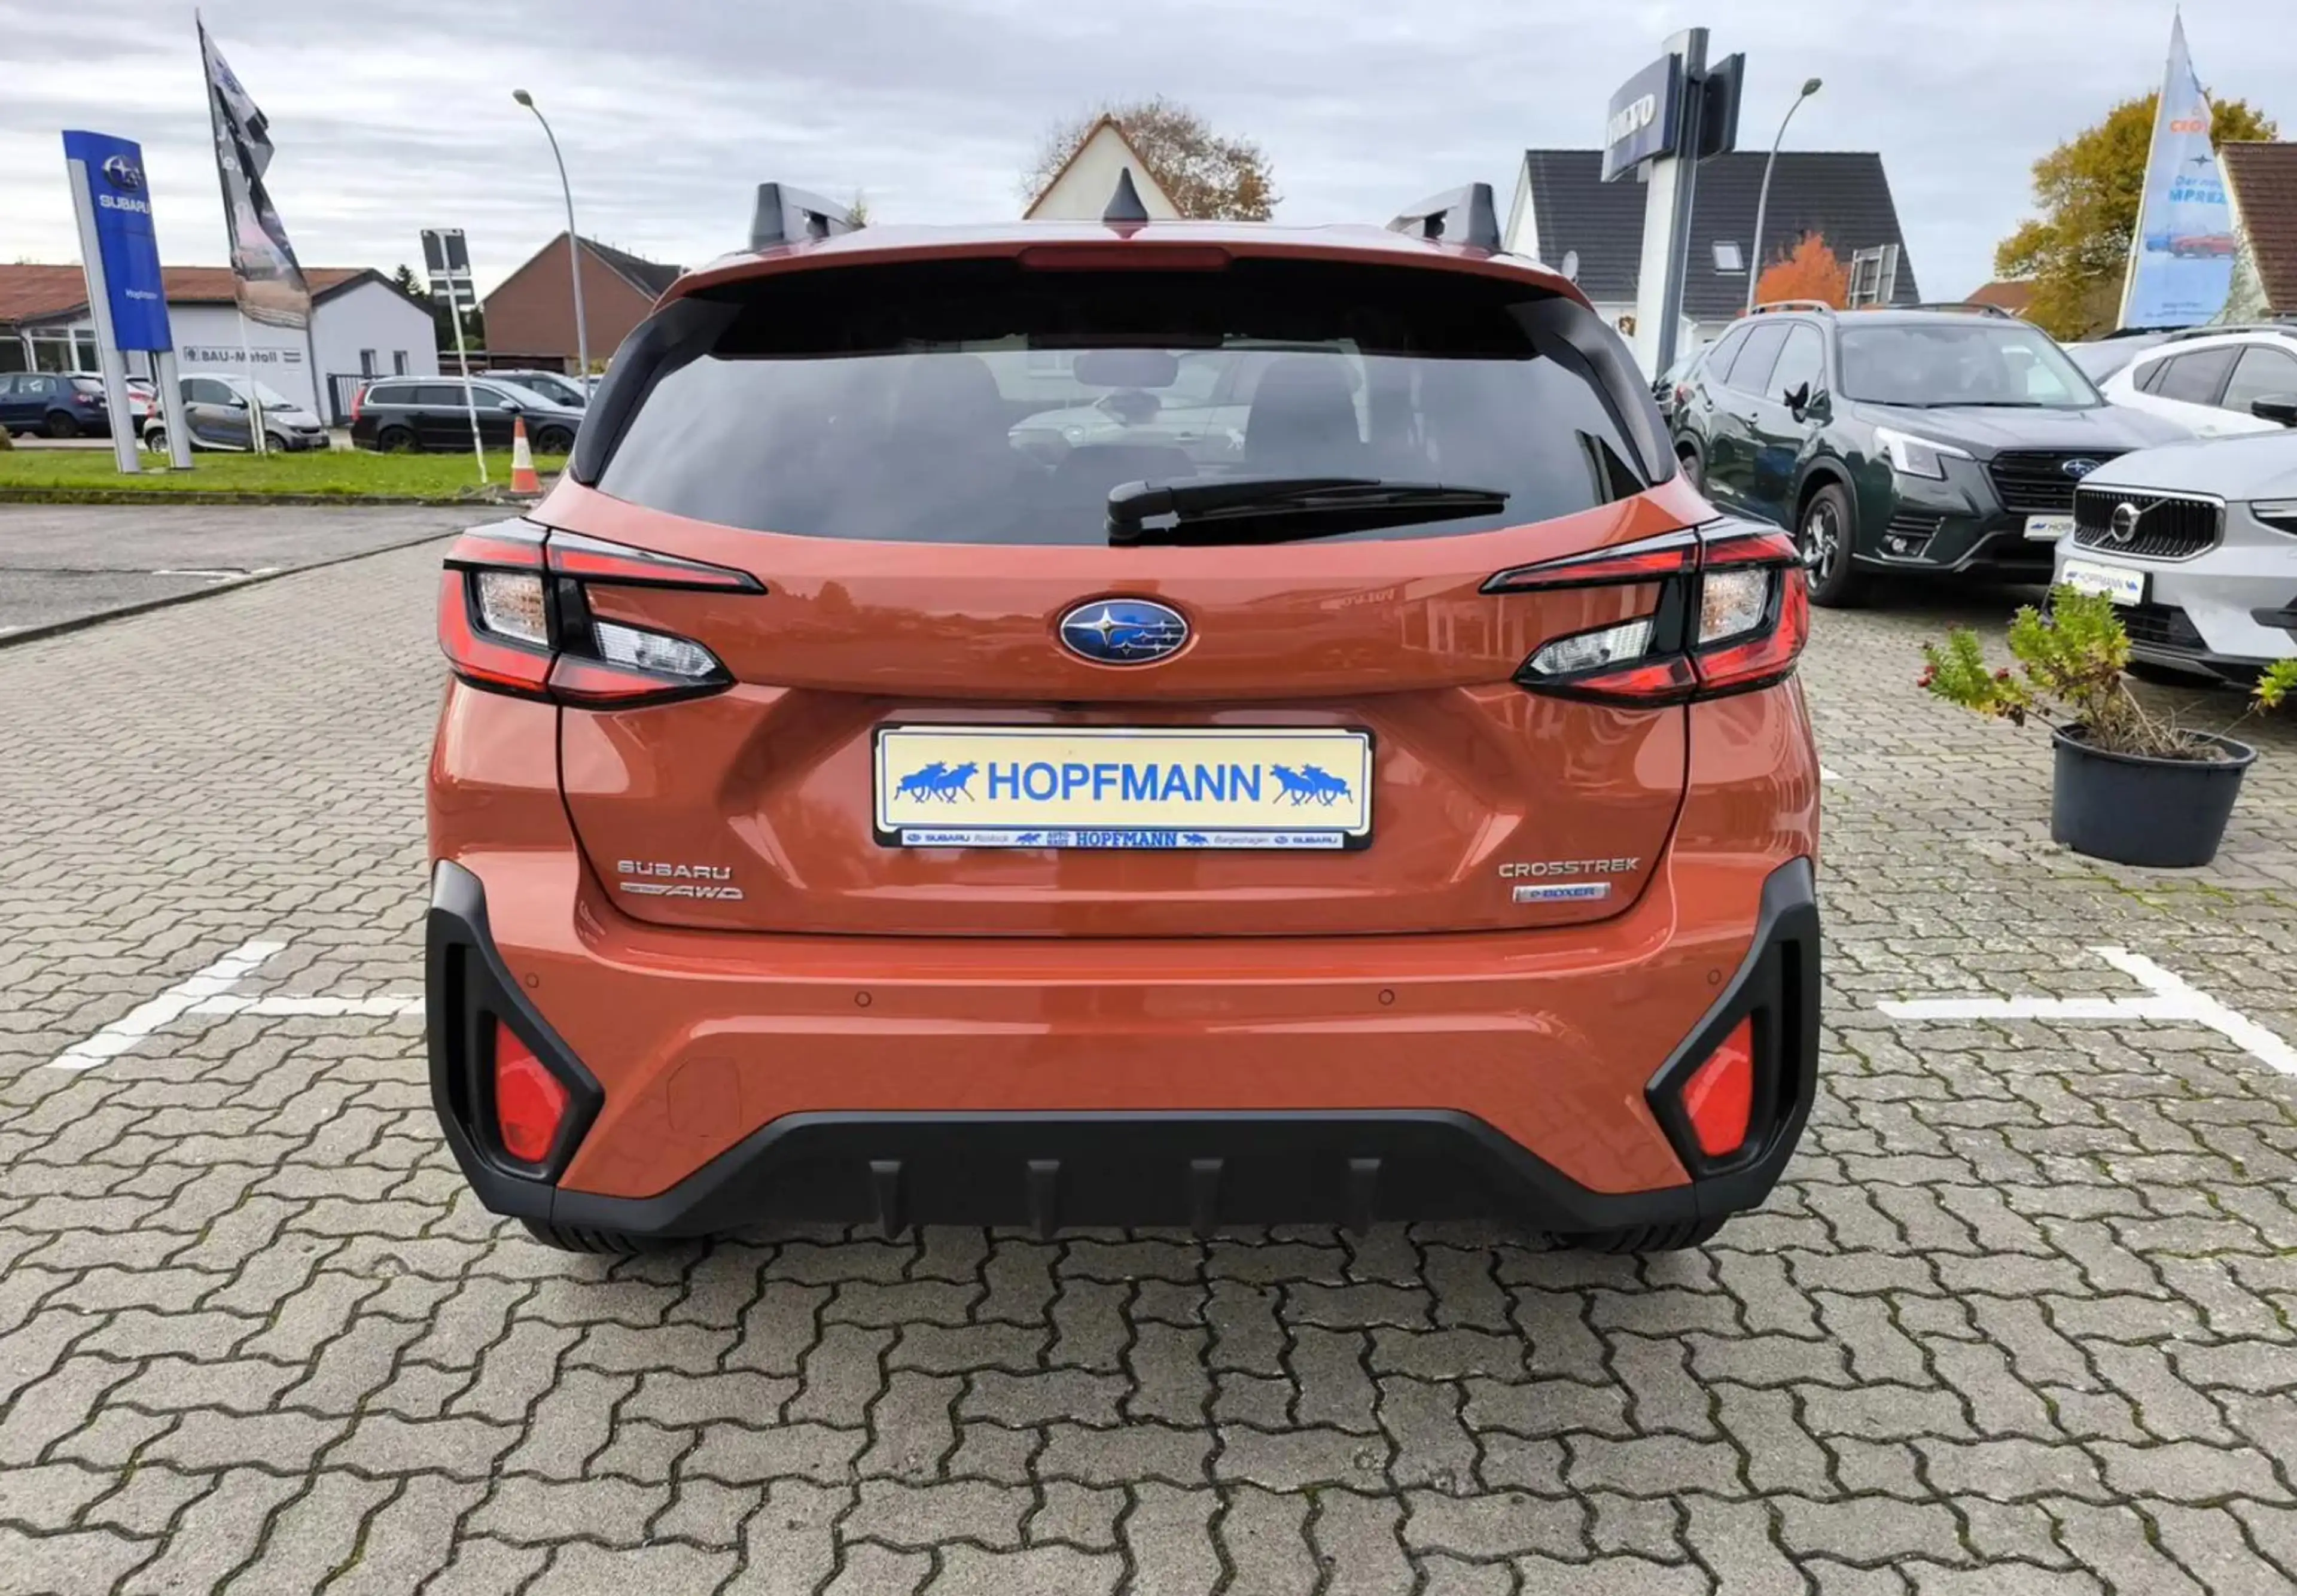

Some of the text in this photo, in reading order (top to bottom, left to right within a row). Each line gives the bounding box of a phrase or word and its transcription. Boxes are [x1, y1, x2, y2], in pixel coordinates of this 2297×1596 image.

[99, 194, 150, 214] SUBARU
[988, 762, 1261, 801] HOPFMANN
[1076, 831, 1178, 846] HOPFMANN
[618, 860, 731, 879] SUBARU
[1498, 857, 1641, 878] CROSSTREK
[666, 885, 744, 900] AWD
